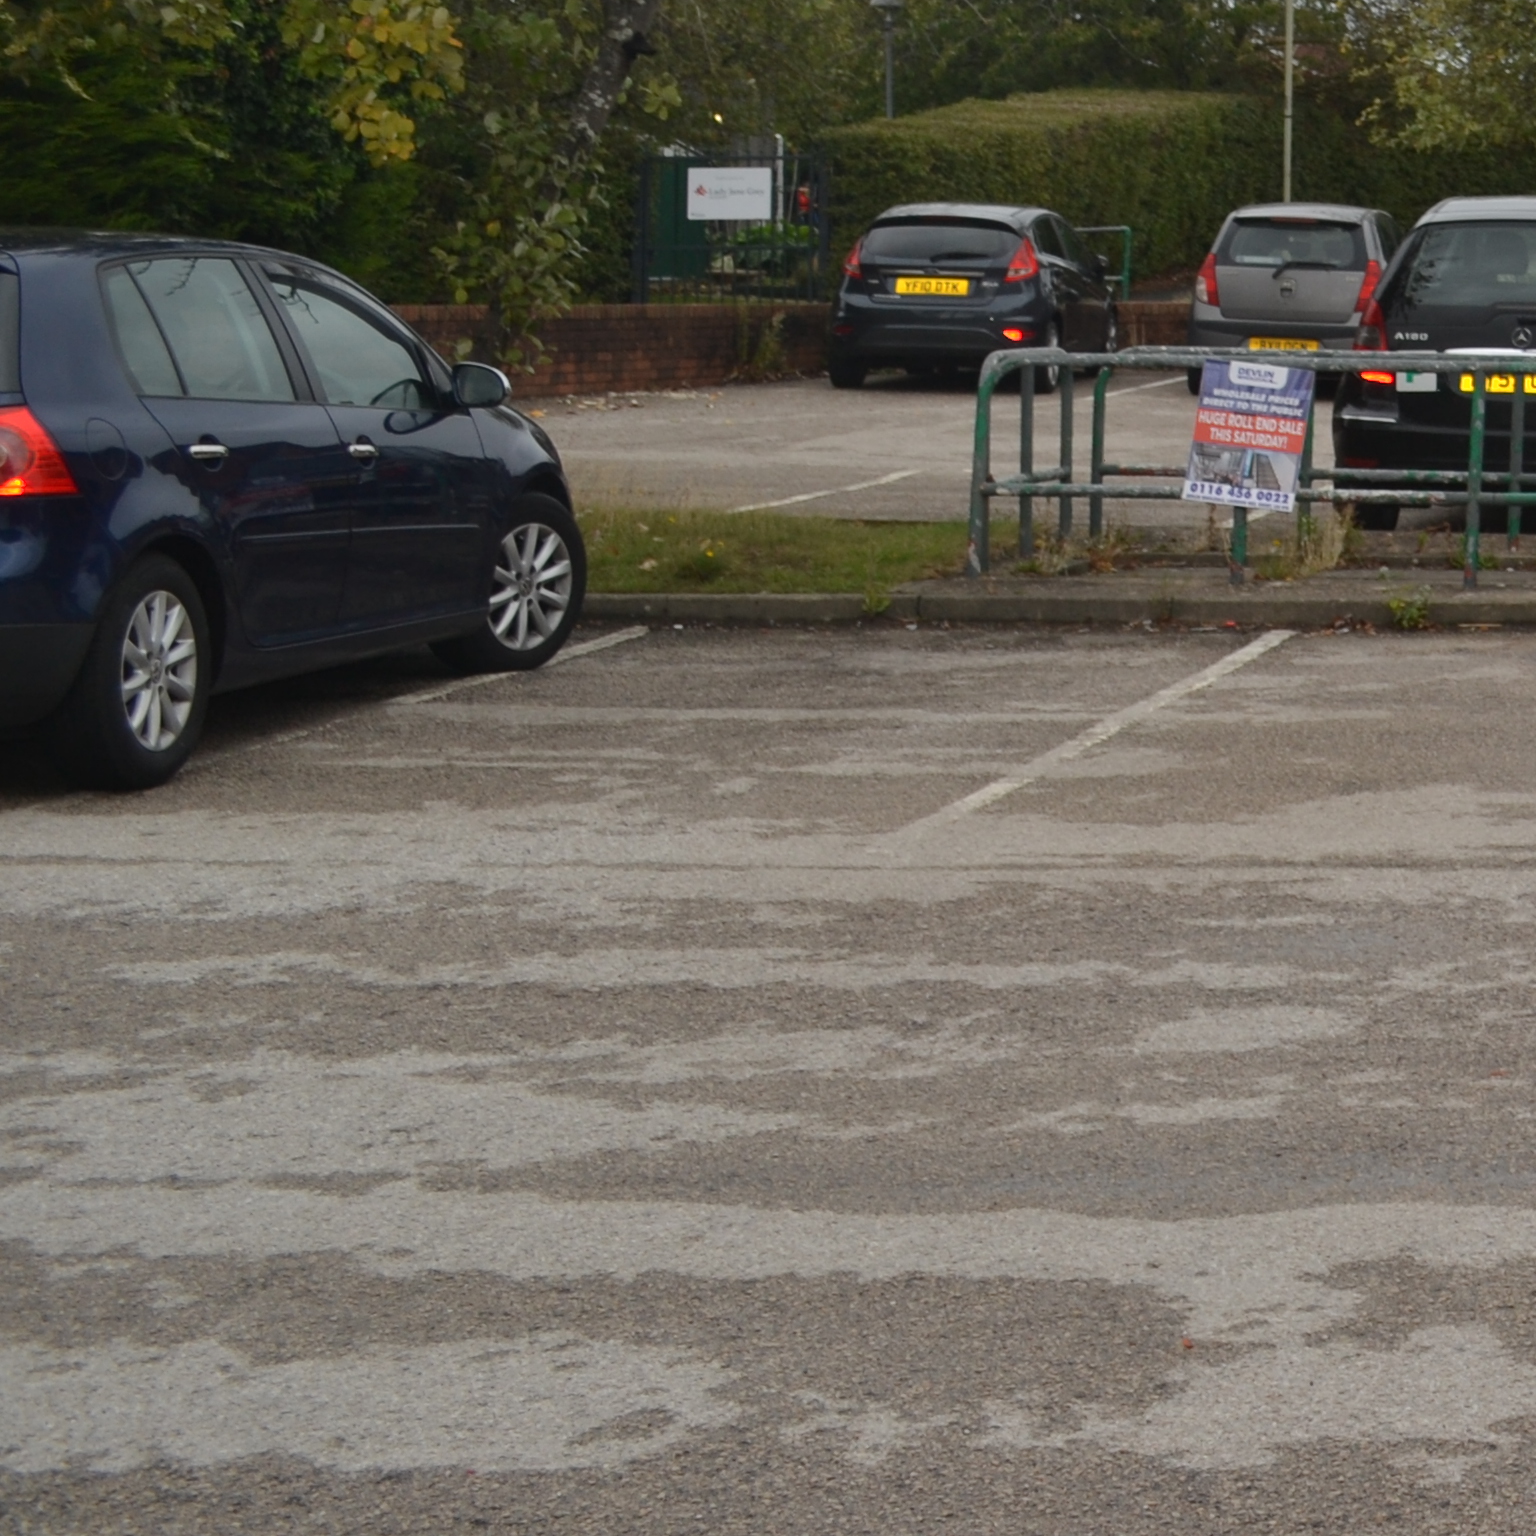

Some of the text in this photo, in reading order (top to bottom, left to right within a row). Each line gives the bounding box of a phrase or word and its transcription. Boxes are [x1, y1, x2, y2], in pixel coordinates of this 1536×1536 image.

[1237, 367, 1275, 379] DEVLIN
[1202, 397, 1304, 417] DIRECT TO THE PUBLIC
[1213, 388, 1300, 406] WHOLESALE PRICES
[1198, 410, 1304, 436] HUGE ROLL END SALE
[1210, 427, 1288, 449] THIS SATURDAY!
[1190, 483, 1223, 496] 0116
[1227, 486, 1253, 500] 456
[1256, 490, 1290, 505] 0022
